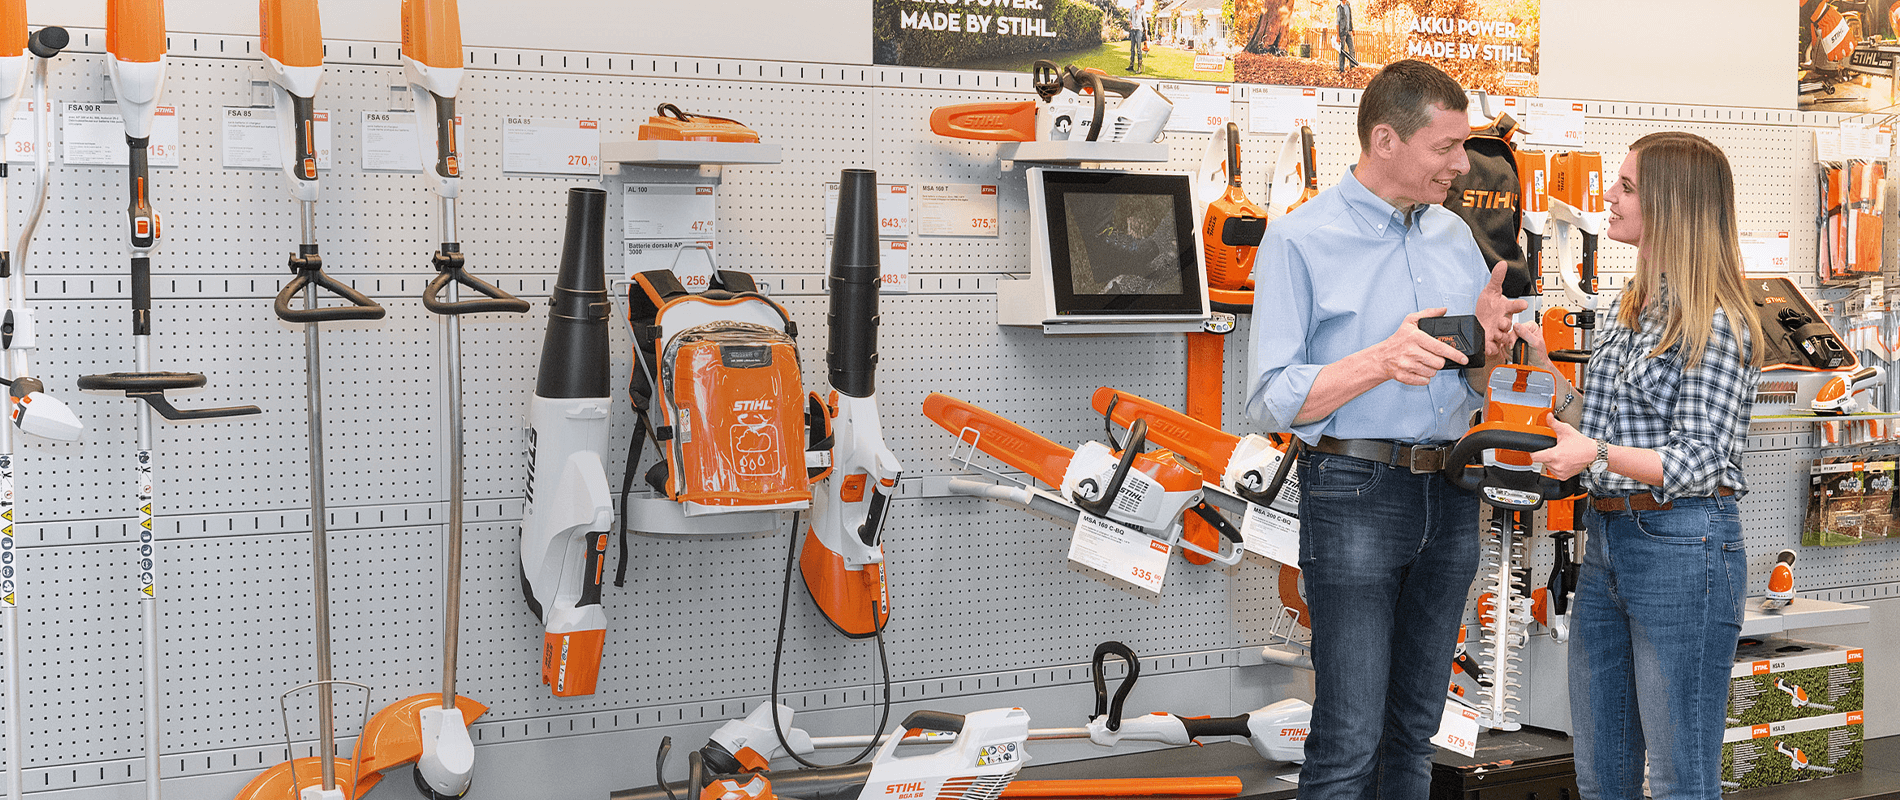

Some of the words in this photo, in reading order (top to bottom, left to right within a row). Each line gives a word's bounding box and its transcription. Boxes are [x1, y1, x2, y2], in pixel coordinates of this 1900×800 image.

[900, 9, 960, 32] MADE
[966, 13, 993, 34] BY
[996, 15, 1057, 38] STIHL.
[1408, 16, 1454, 35] AKKU
[1457, 18, 1521, 39] POWER.
[1408, 40, 1455, 58] MADE
[1459, 43, 1480, 60] BY
[1482, 44, 1531, 63] STIHL.
[1852, 51, 1879, 66] STIHL
[68, 104, 83, 112] FSA
[964, 115, 1004, 127] STIHL
[568, 155, 591, 167] 270,
[691, 221, 708, 232] 47,
[881, 218, 902, 229] 643,
[971, 218, 991, 229] 375,
[686, 275, 709, 286] 256,
[881, 274, 901, 285] 483,
[1765, 296, 1787, 304] STIHL
[733, 400, 774, 411] STIHL
[1153, 418, 1190, 442] STIHL
[983, 428, 1026, 453] STIHL
[525, 425, 538, 504] STIHL
[1119, 486, 1143, 502] STIHL
[1253, 506, 1266, 516] MSA
[1266, 511, 1277, 520] 200
[1276, 515, 1292, 526] C-BQ
[1083, 515, 1097, 525] MSA
[1109, 524, 1125, 536] C-BQ
[1151, 542, 1168, 552] STIHL
[1131, 566, 1154, 584] 335,
[1280, 727, 1309, 737] STIHL
[1447, 734, 1467, 750] 579,
[885, 781, 926, 794] STIHL
